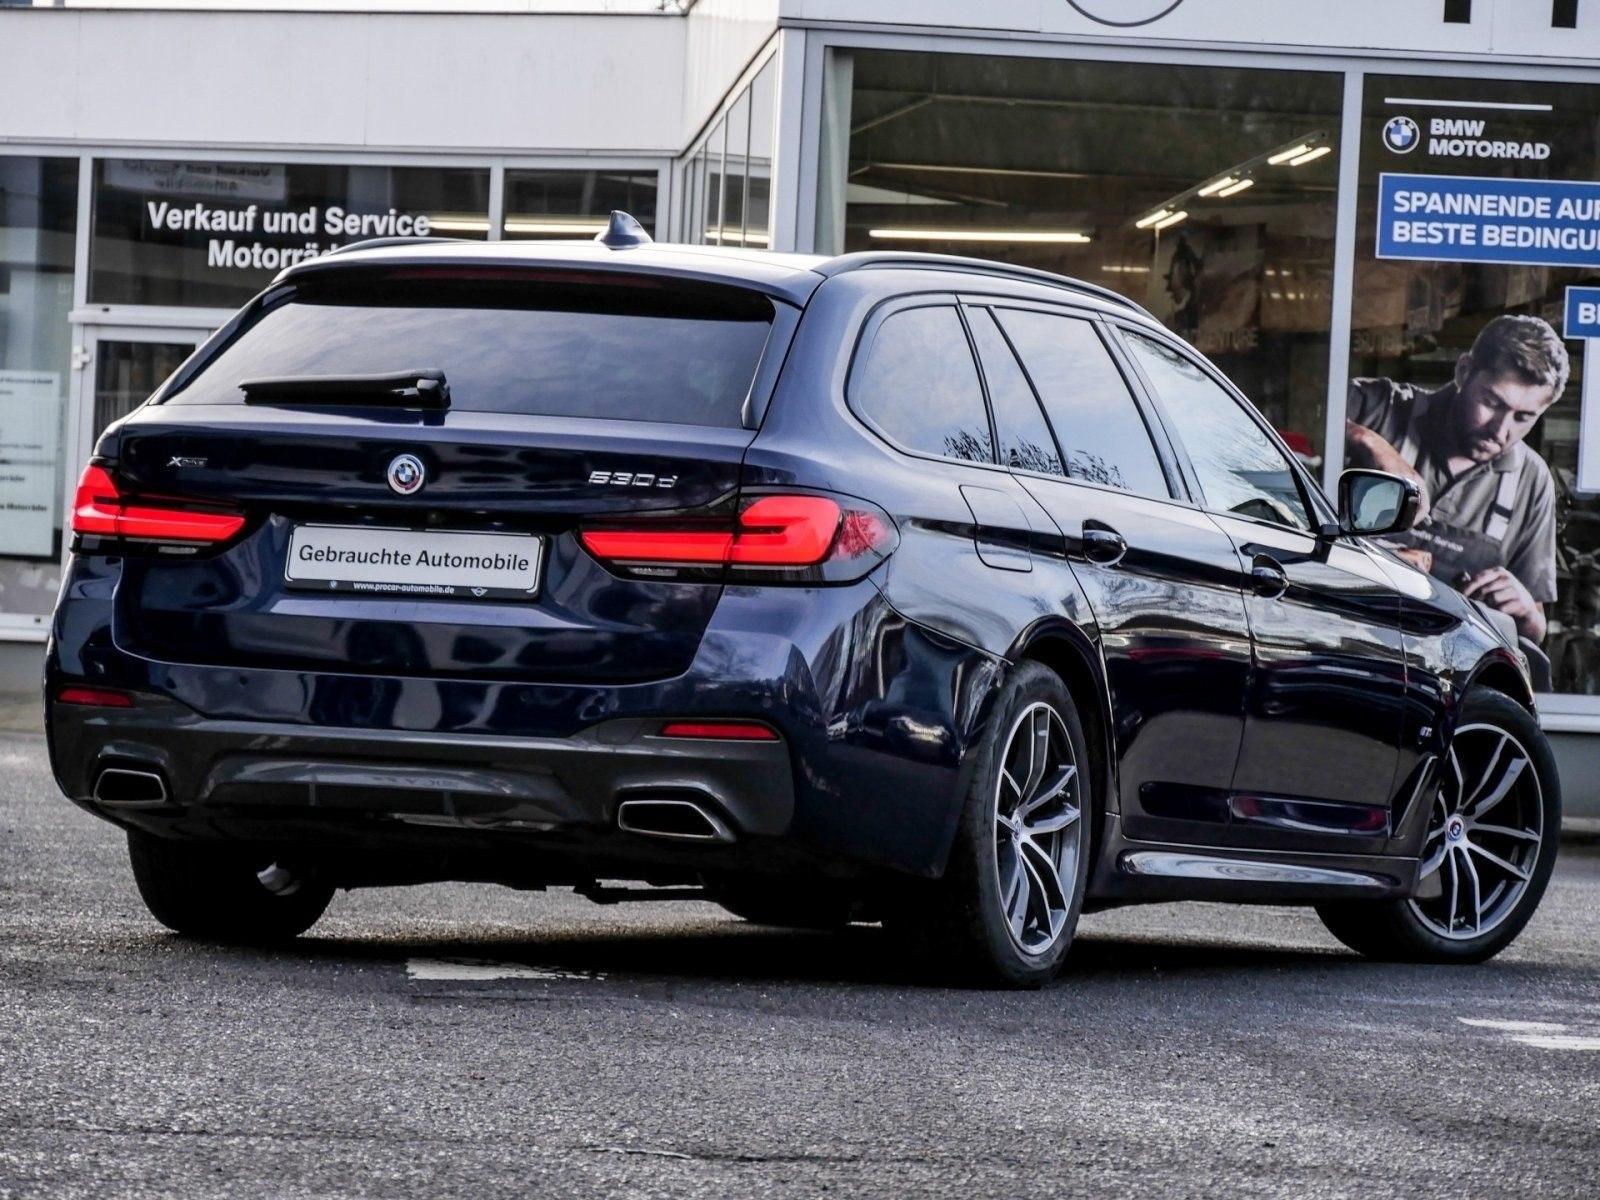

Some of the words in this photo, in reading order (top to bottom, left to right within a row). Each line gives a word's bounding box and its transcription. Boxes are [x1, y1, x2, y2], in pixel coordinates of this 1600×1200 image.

[1430, 118, 1485, 137] BMW
[1428, 138, 1551, 160] MOTORRAD
[1393, 190, 1551, 219] SPANNENDE
[148, 202, 257, 233] Verkauf
[263, 206, 317, 234] und
[324, 207, 430, 237] Service
[1393, 220, 1476, 246] BESTE
[1482, 224, 1600, 251] BEDINGU
[589, 471, 678, 488] 530d
[299, 545, 411, 567] Gebrauchte
[416, 550, 529, 572] Automobile
[353, 581, 455, 595] www.procar-automobile.de
